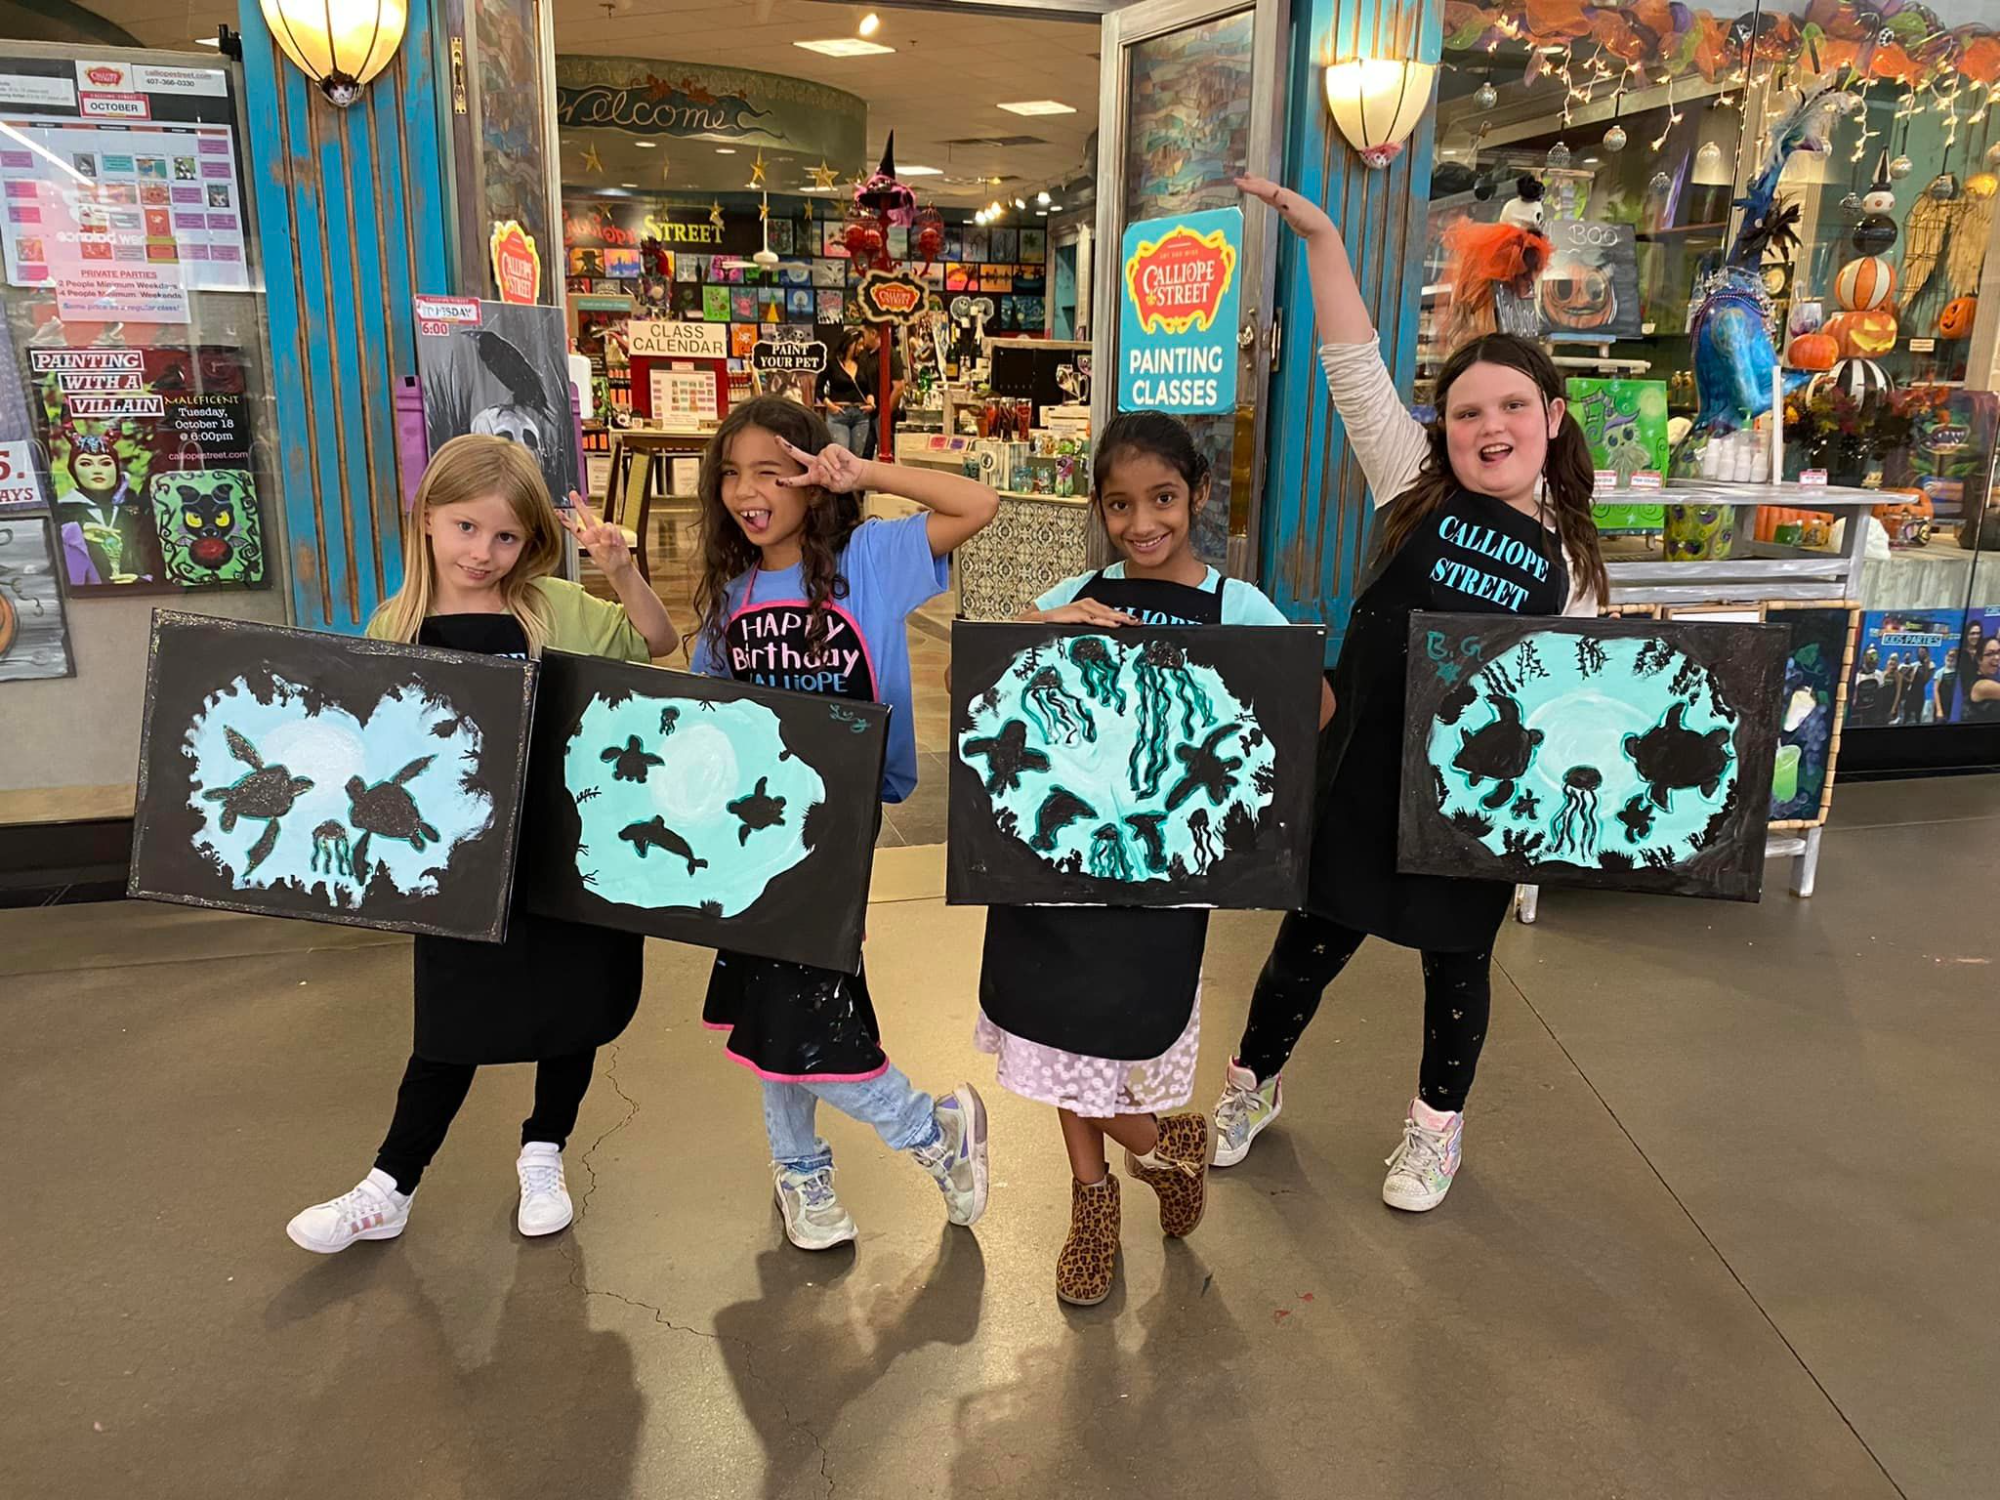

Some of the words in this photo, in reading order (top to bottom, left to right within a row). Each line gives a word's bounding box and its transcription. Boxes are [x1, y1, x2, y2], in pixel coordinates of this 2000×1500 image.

[90, 102, 138, 112] OCTOBER
[641, 215, 725, 243] STREET
[1568, 224, 1618, 247] BOO
[81, 269, 117, 279] PRIVATE
[120, 270, 157, 280] PARTIES
[1142, 259, 1215, 294] CALLIOPE
[66, 281, 94, 289] People
[97, 281, 135, 289] Minimum
[67, 290, 95, 298] People
[1156, 282, 1210, 306] STREET
[422, 322, 449, 335] 6:00
[650, 324, 704, 339] CLASS
[633, 337, 724, 354] CALENDAR
[772, 345, 809, 356] PAINT
[37, 354, 139, 368] PAINTING
[760, 357, 794, 368] YOUR
[796, 357, 819, 368] PET
[1130, 346, 1223, 375] PAINTING
[65, 375, 119, 389] WITH
[124, 375, 139, 389] A
[1132, 379, 1218, 406] CLASSES
[74, 399, 158, 413] VILLAIN
[164, 395, 240, 405] MALEFICENT
[178, 407, 229, 418] Tuesday,
[175, 420, 218, 429] October
[221, 419, 235, 429] 18
[190, 431, 234, 442] 6:00pm
[168, 451, 249, 460] calliopestreet.com
[1438, 515, 1550, 583] CALLIOPE
[1429, 557, 1530, 612] STREET
[1905, 635, 1940, 646] PARTIES
